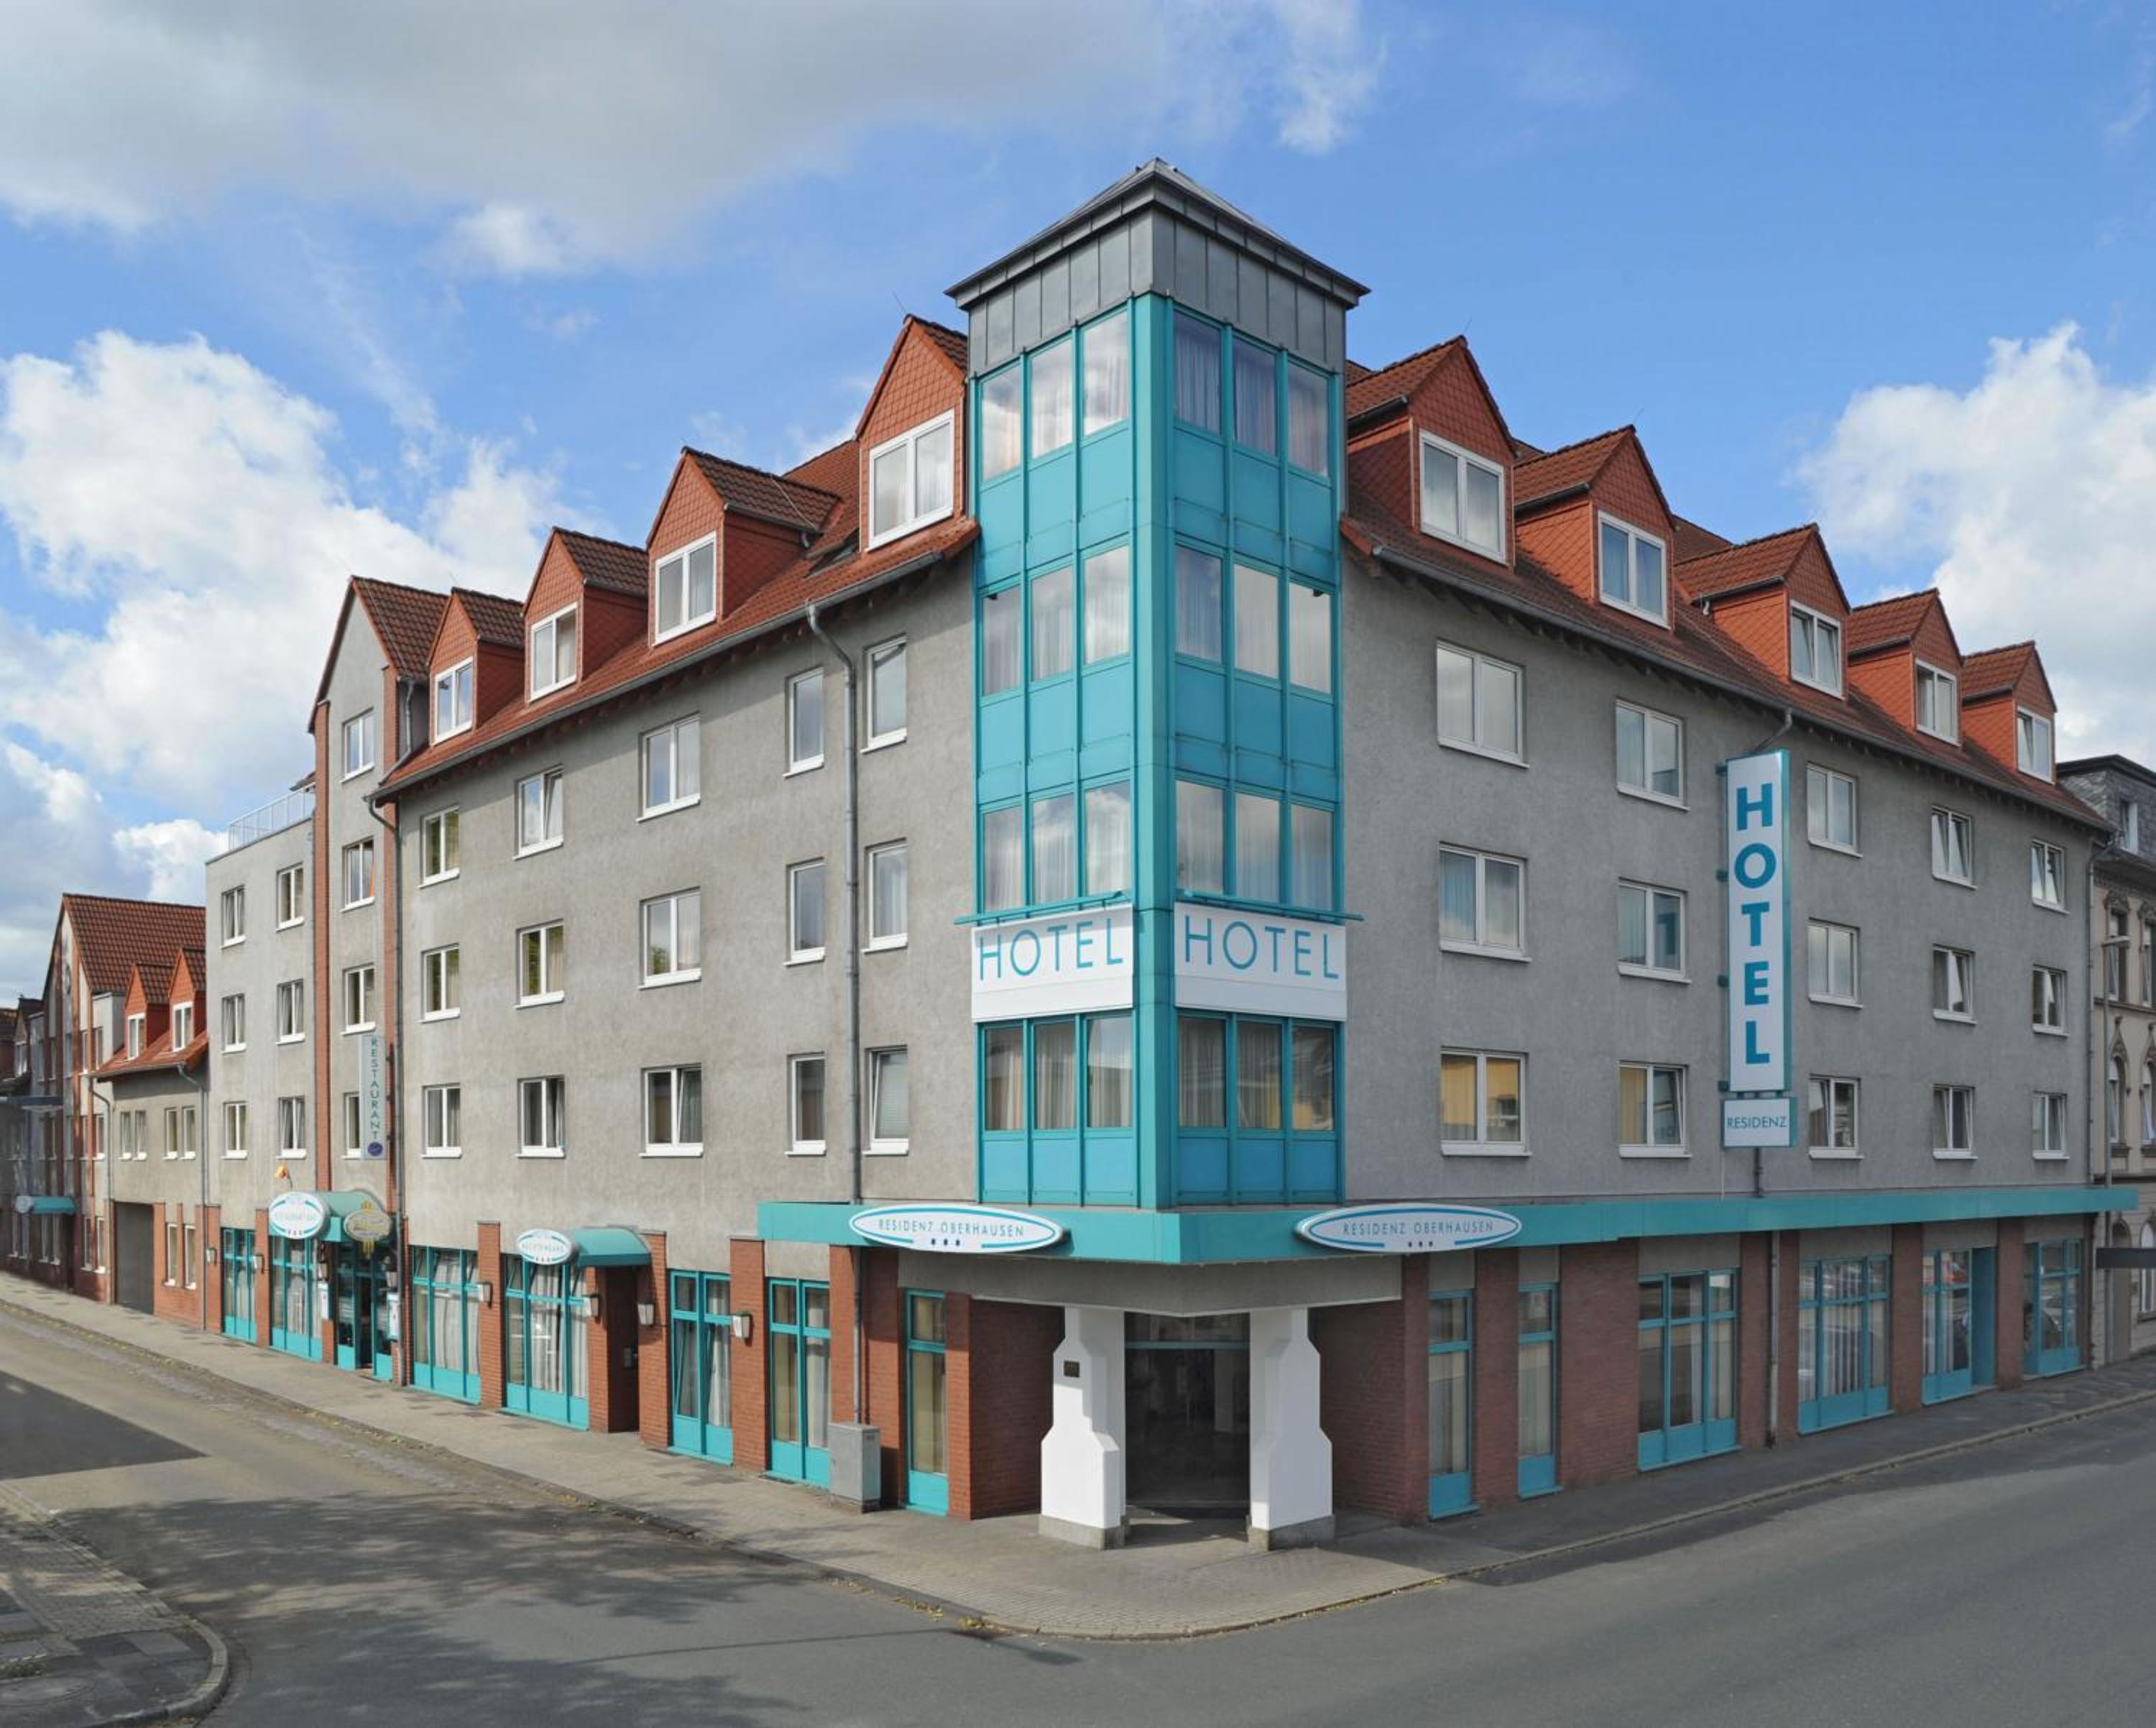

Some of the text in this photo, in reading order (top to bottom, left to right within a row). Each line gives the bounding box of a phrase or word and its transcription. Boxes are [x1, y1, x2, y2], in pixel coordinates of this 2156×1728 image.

[980, 917, 1123, 980] HOTEL
[1184, 914, 1339, 979] HOTEL
[1734, 782, 1777, 1065] HOTEL
[370, 1035, 380, 1139] RESTAURANT
[1726, 1116, 1788, 1129] RESIDENZ
[877, 1218, 1024, 1237] RESIDENZ OBERHAUSEN
[1342, 1221, 1493, 1236] RESIDENZ OBERHAUSEN
